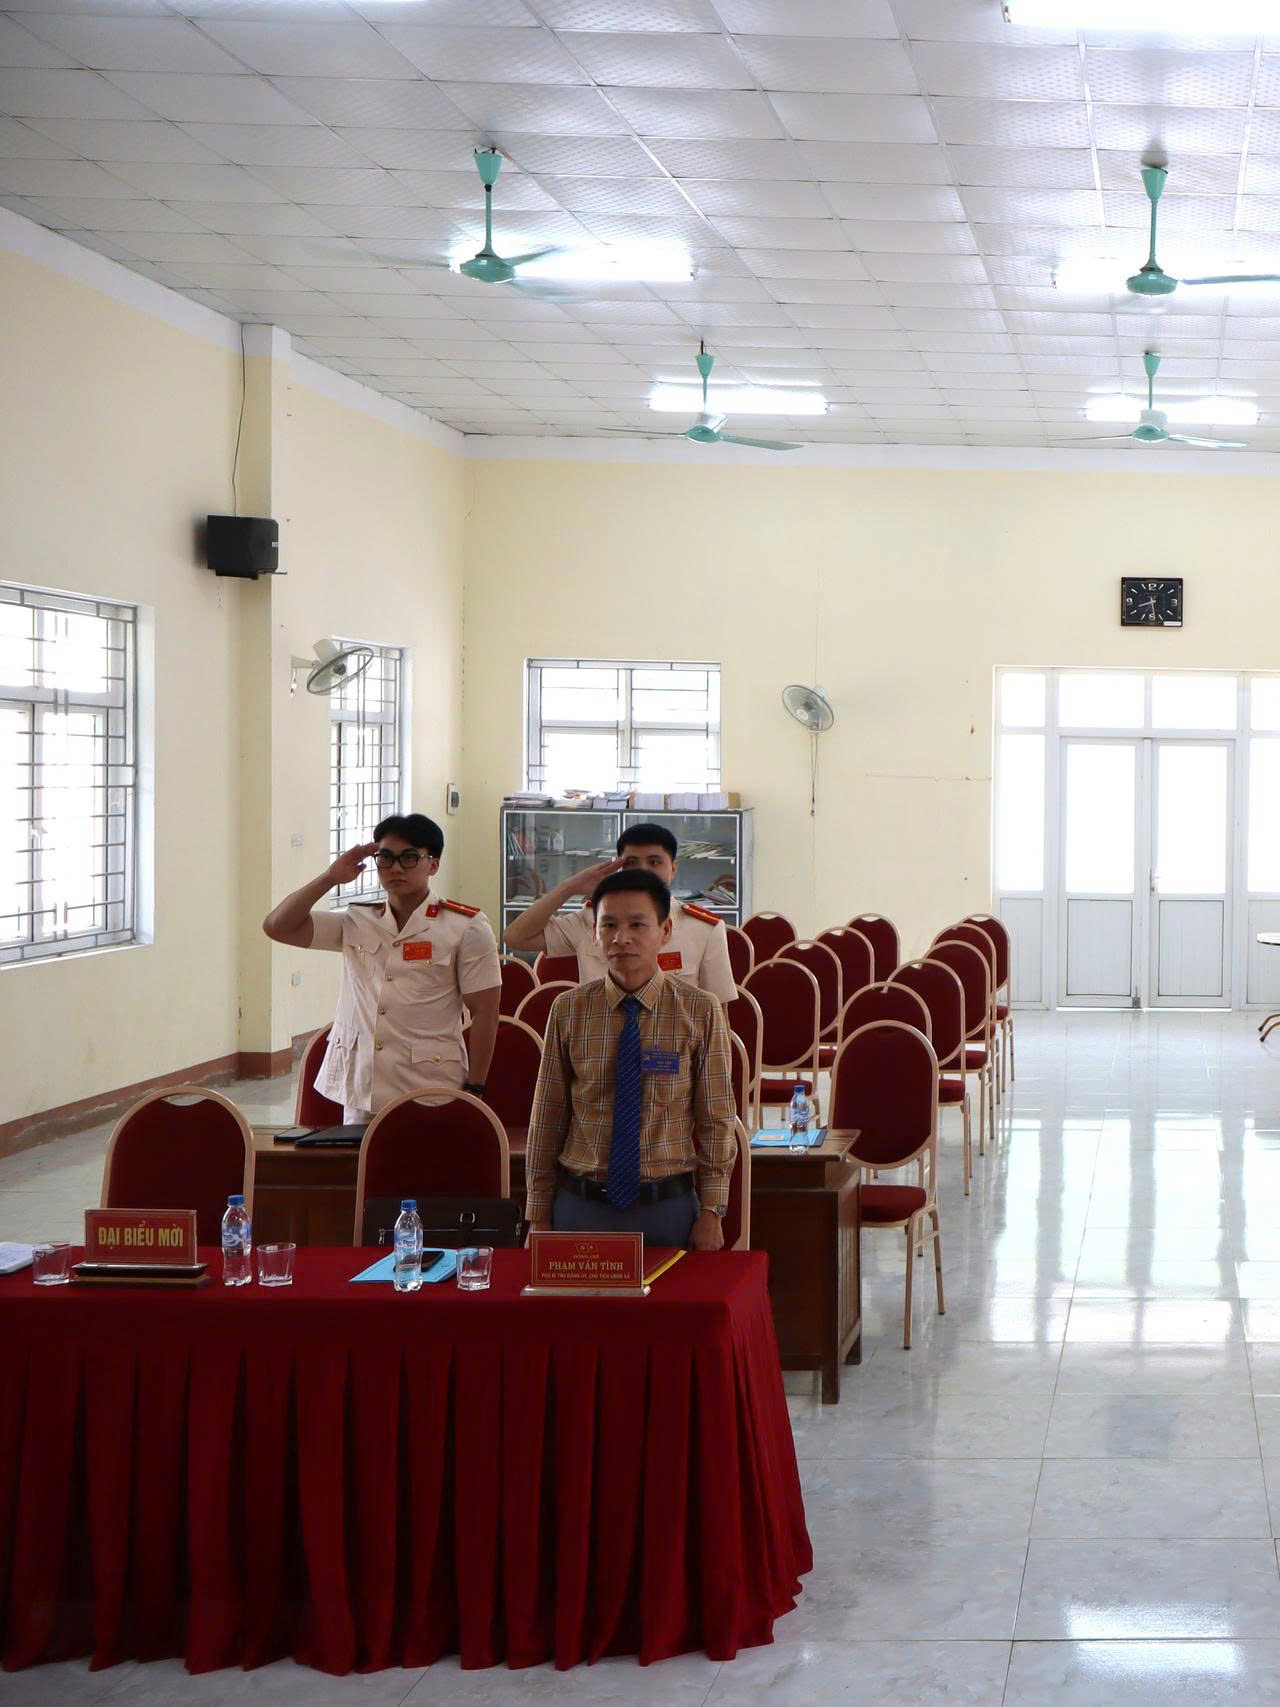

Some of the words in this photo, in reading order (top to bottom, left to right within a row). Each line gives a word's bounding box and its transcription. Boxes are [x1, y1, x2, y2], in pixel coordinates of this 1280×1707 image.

[98, 1226, 120, 1250] ĐẠI
[124, 1220, 154, 1246] BIỂU
[158, 1224, 184, 1247] MỜI
[549, 1261, 576, 1272] PHẠM
[578, 1259, 598, 1270] VĂN
